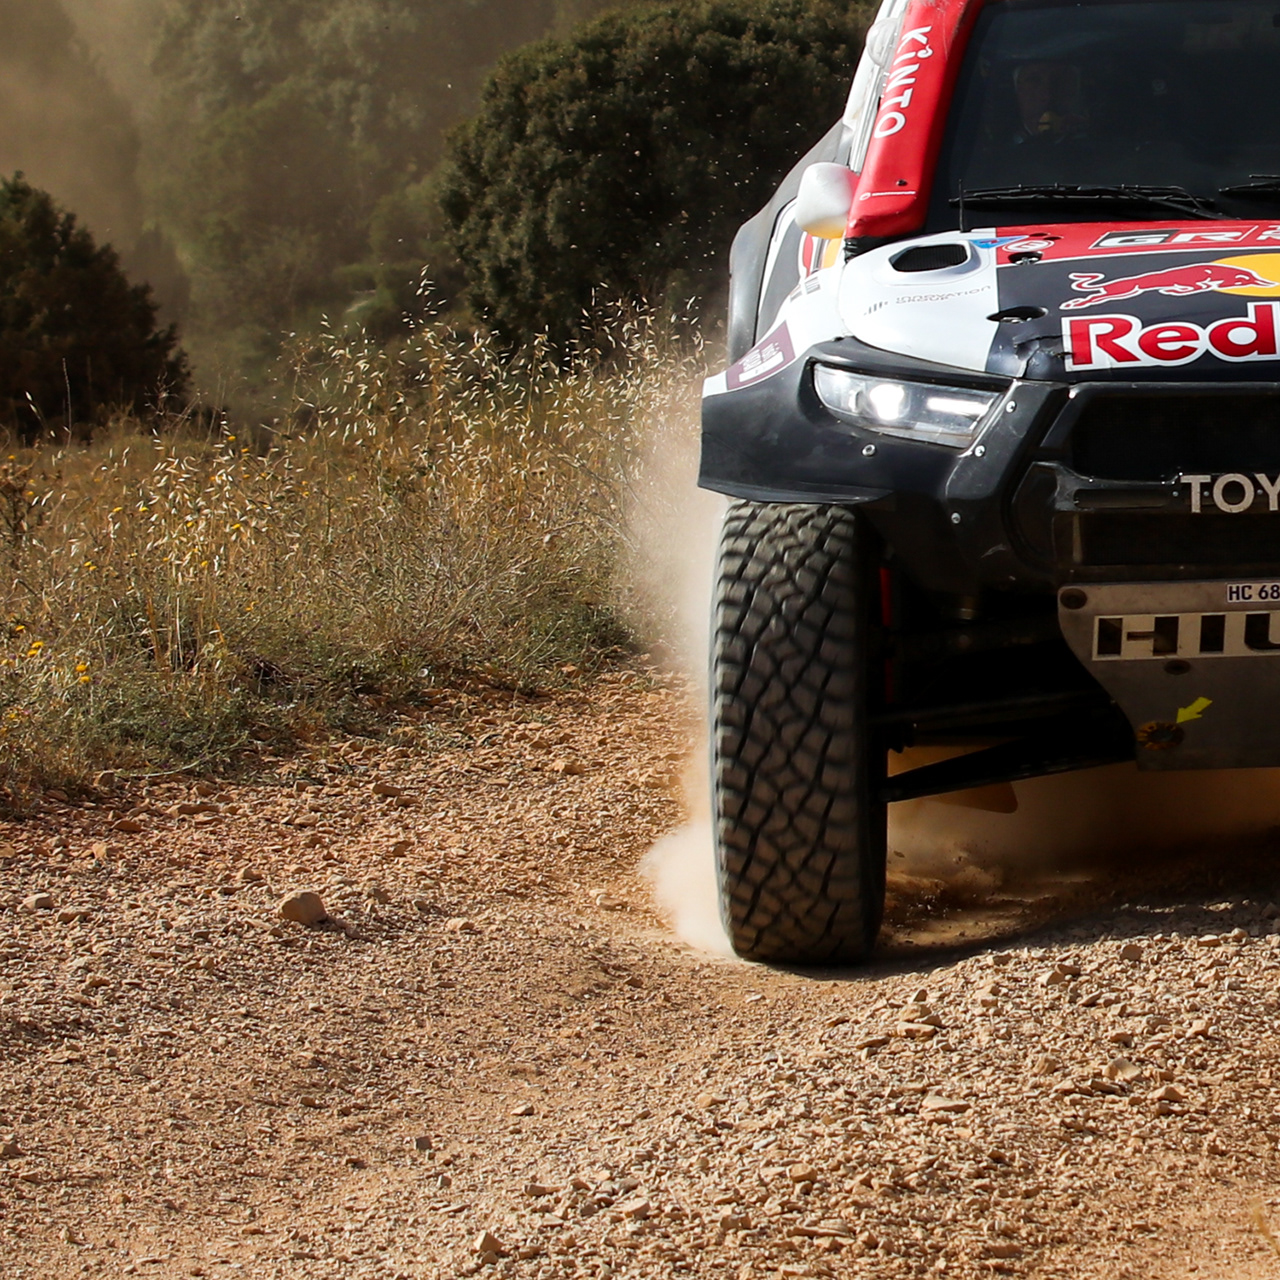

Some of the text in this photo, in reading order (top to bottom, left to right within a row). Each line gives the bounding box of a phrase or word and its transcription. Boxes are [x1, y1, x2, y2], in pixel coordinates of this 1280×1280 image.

[1098, 230, 1243, 248] GR
[1067, 303, 1275, 366] Red
[1228, 585, 1252, 601] HC
[1258, 584, 1280, 600] 68
